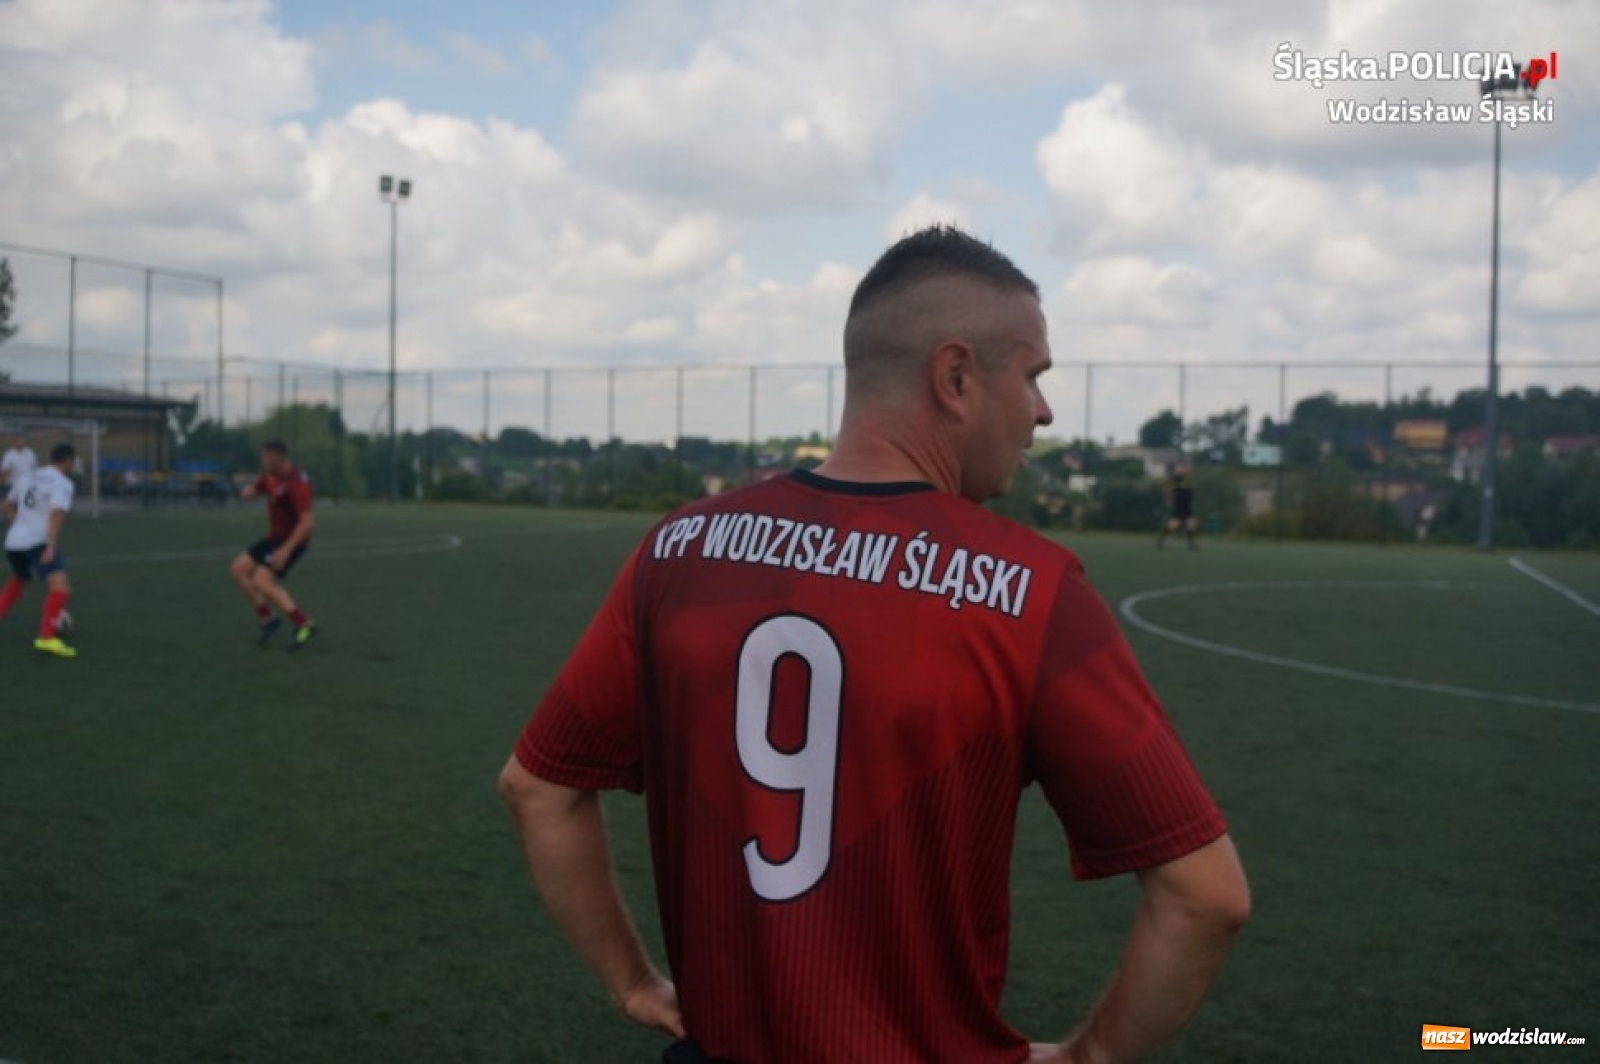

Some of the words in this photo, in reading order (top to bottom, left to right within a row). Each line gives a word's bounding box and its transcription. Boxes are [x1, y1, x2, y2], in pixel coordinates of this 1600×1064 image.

[702, 513, 897, 583] WODZISŁAW
[898, 531, 1032, 617] ŚLĄSKI
[735, 613, 844, 901] 9
